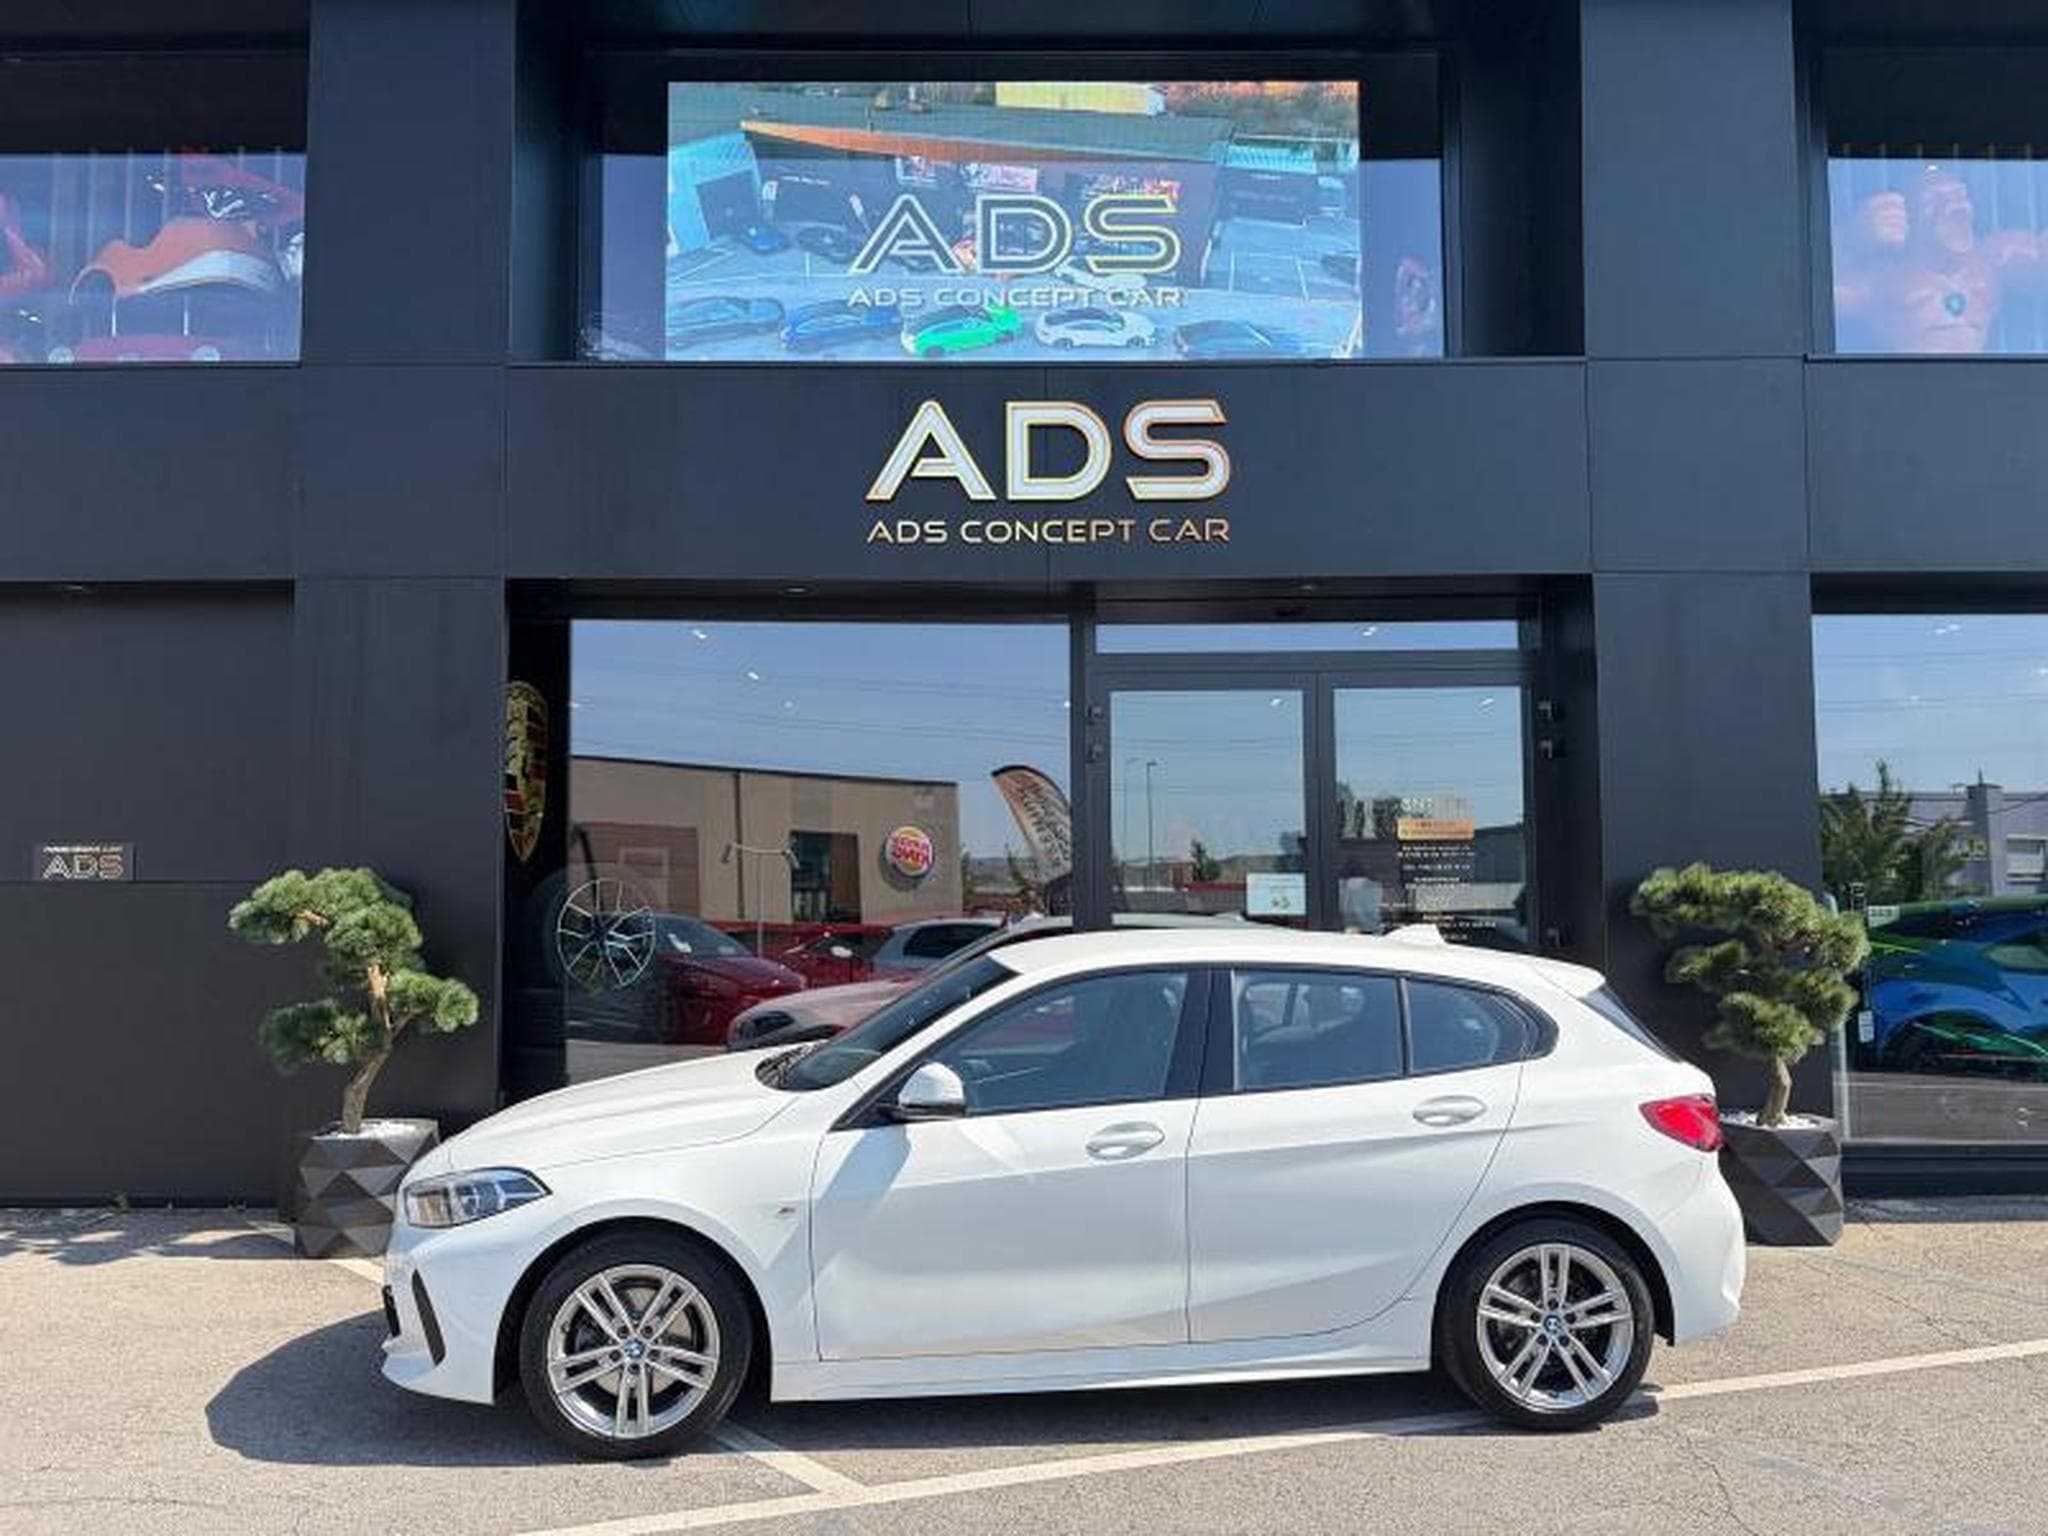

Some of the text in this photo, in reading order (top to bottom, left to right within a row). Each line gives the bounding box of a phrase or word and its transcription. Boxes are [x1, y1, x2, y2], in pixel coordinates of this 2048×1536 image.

[850, 194, 1181, 273] ADS
[849, 287, 1181, 306] ADS CONCEPT CAR
[866, 400, 1231, 501] ADS
[867, 519, 1231, 543] ADS CONCEPT CAR
[43, 855, 124, 879] ADS
